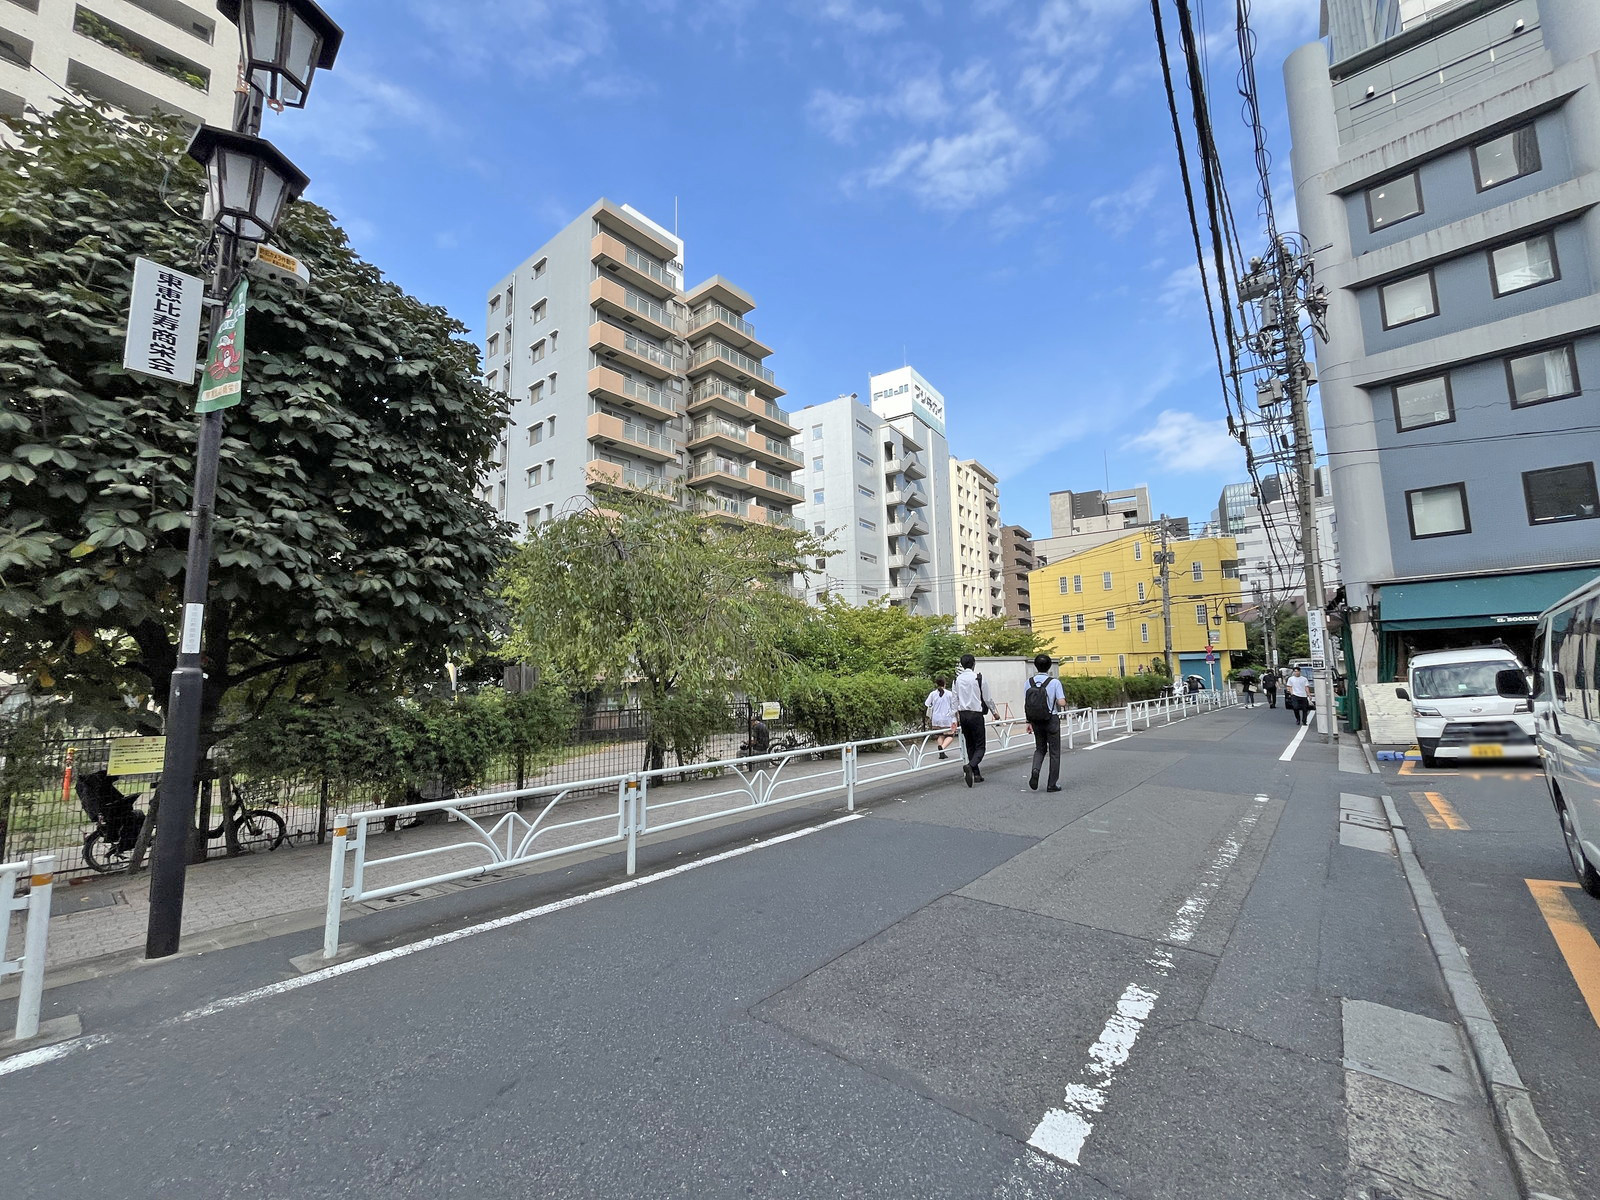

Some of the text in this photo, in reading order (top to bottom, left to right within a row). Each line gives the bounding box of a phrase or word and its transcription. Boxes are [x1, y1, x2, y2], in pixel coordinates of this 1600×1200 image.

[148, 270, 184, 375] 東恵比寿商栄会
[873, 384, 909, 402] FUJI
